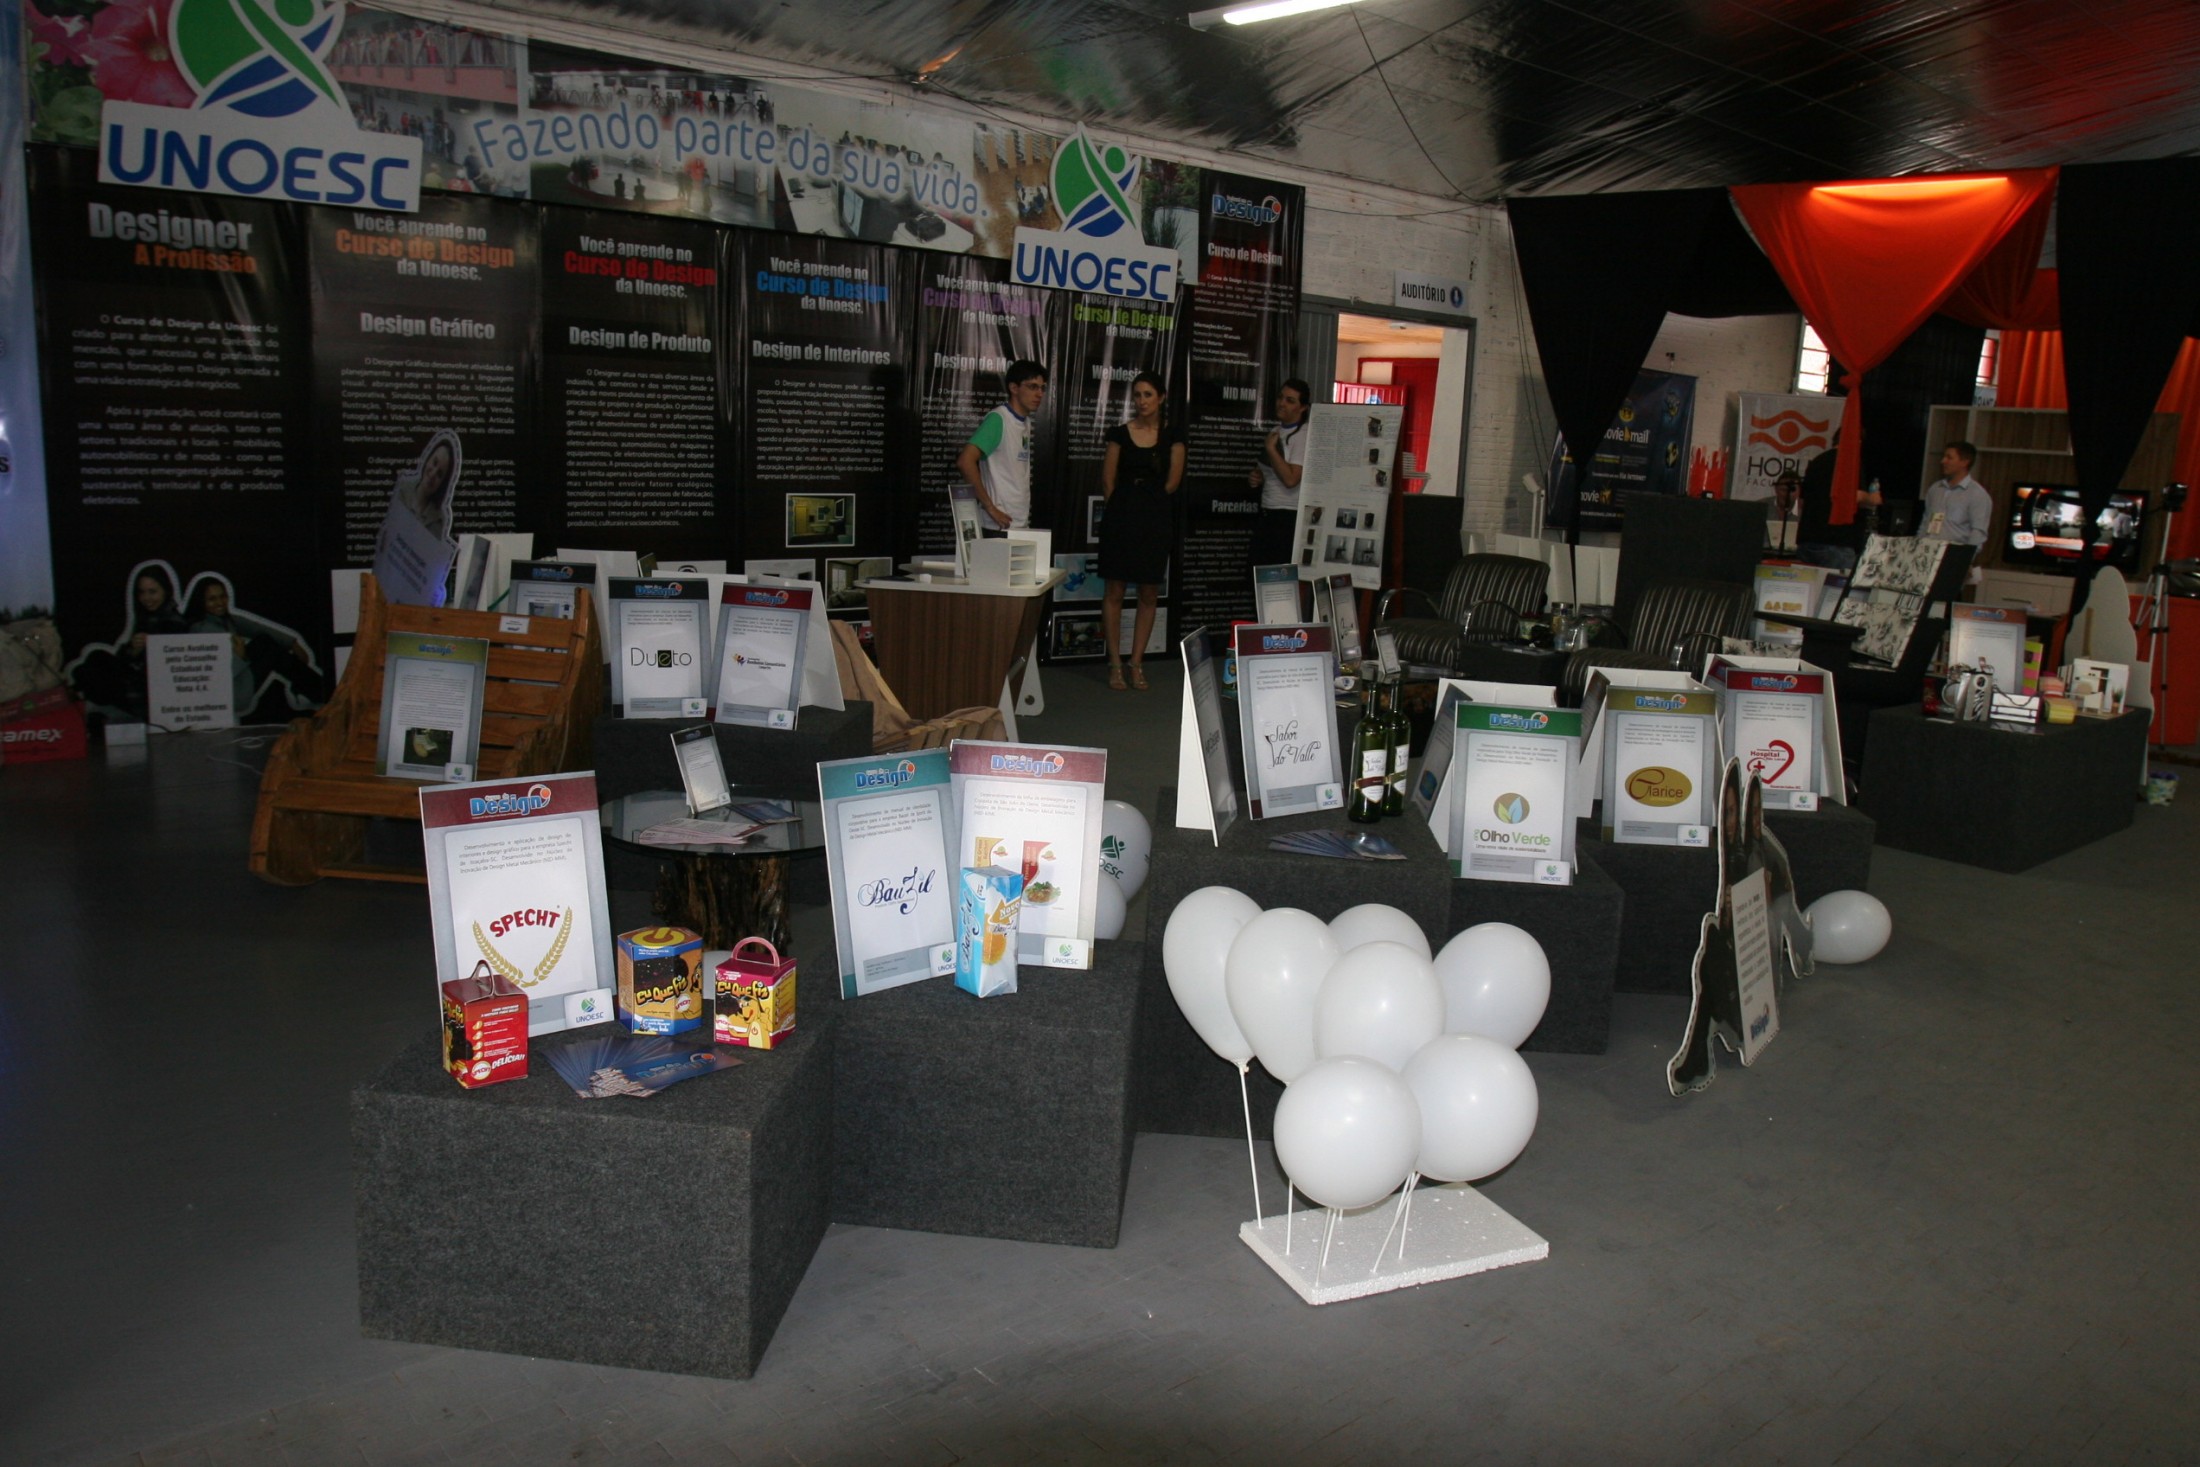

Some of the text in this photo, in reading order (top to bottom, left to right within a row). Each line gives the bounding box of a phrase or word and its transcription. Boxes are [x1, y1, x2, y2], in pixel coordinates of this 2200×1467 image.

[108, 123, 409, 209] UNOESC
[474, 102, 988, 217] Fazendo parte da sua vida.
[1212, 194, 1273, 226] Design
[87, 202, 252, 250] Designer
[354, 212, 487, 241] Você aprende no
[133, 242, 257, 274] A Profissão
[335, 228, 515, 269] Curso de Design
[580, 235, 692, 262] Você aprende no
[1208, 242, 1282, 266] Curso de Design
[397, 259, 482, 281] da Unoesc.
[564, 250, 716, 287] Curso de Design
[770, 257, 868, 280] Você aprende no
[1016, 242, 1171, 300] UNOESC
[616, 277, 688, 298] da Unoesc.
[757, 271, 889, 303] Curso de Design
[937, 274, 1023, 295] Você aprende no
[1401, 283, 1445, 302] AUDITÓRIO
[801, 295, 864, 314] da Unoesc.
[924, 287, 1040, 316] Curso de Design
[1148, 301, 1158, 311] no
[100, 314, 278, 333] O Curso de Design da Unoesc foi
[360, 312, 495, 339] Design Gráfico
[963, 309, 1018, 327] da Unoesc.
[1074, 303, 1174, 332] Curso de Design
[72, 329, 106, 339] criado
[110, 332, 134, 342] para
[139, 332, 178, 342] atender
[265, 338, 279, 348] do
[569, 326, 712, 352] Design de Produto
[1106, 324, 1153, 340] da Unoesc.
[753, 339, 891, 365] Design de Interiores
[934, 352, 1014, 373] Design de Mo
[1092, 365, 1144, 382] Webdesi
[1223, 386, 1256, 400] NID MM
[1604, 427, 1624, 441] ovie
[1212, 499, 1258, 512] Parcerias
[635, 584, 677, 597] Design
[744, 591, 782, 607] Design
[1971, 608, 2001, 619] Design
[187, 644, 218, 652] Avaliado
[418, 644, 452, 655] Design
[1263, 635, 1302, 652] Design
[166, 654, 217, 664] pelo Conselho
[631, 647, 692, 668] Dueto
[171, 664, 198, 673] Estadual
[1751, 677, 1793, 690] Design
[194, 704, 227, 712] melhores
[1635, 696, 1680, 710] Design
[1270, 719, 1299, 743] Sabor
[1489, 713, 1540, 731] Design
[0, 726, 64, 743] amex
[1275, 740, 1322, 767] do Valle
[1750, 750, 1780, 758] Hospital
[990, 754, 1054, 778] Design
[855, 770, 908, 789] Design
[1628, 768, 1683, 800] Clarice
[469, 794, 543, 817] Design
[1480, 830, 1551, 845] Olho Verde
[1000, 902, 1020, 917] Novo
[489, 908, 560, 938] SPECHT
[575, 1011, 604, 1024] UNOESC
